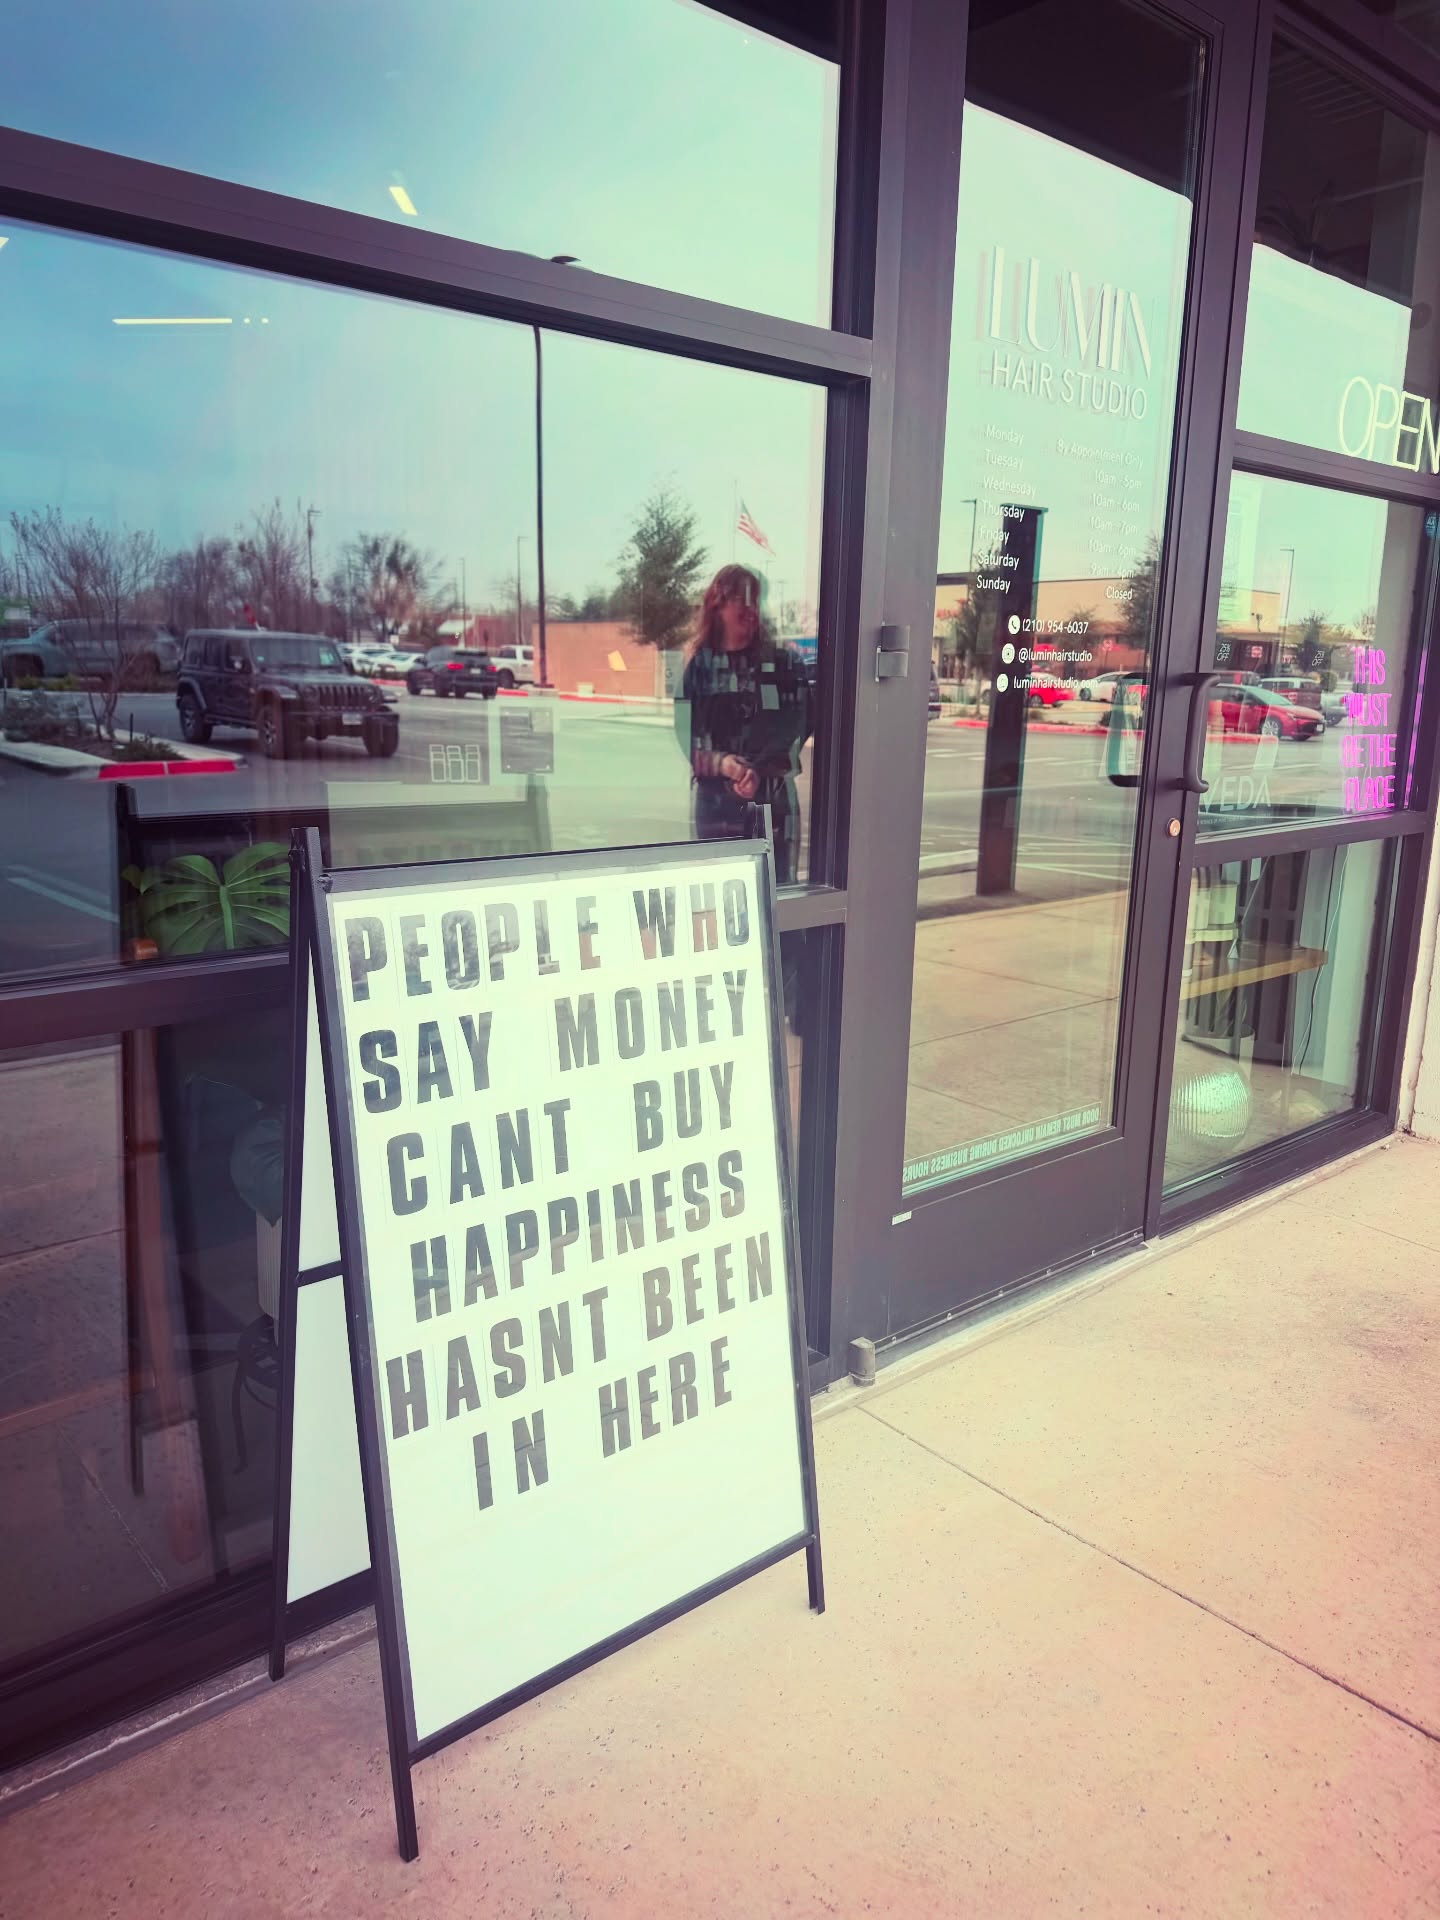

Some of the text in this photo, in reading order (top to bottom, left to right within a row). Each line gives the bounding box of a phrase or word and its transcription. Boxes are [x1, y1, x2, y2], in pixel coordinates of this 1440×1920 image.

[989, 245, 1152, 379] LUMIN
[991, 349, 1148, 421] HAIR STUDIO
[986, 423, 1024, 447] Monday
[1338, 375, 1440, 475] OPEN
[985, 448, 1024, 473] Tuesday
[1071, 441, 1123, 466] Appointment
[1125, 452, 1144, 471] Only
[983, 475, 1037, 499] Wednesday
[981, 500, 1025, 522] Thursday
[980, 526, 1010, 546] Friday
[977, 551, 1020, 571] Saturday
[976, 574, 1011, 594] Sunday
[1106, 586, 1133, 601] Closed
[1022, 618, 1089, 634] (210) 954-6037
[1018, 647, 1092, 664] @luminhairstudio
[1216, 652, 1229, 661] OFF
[1351, 645, 1386, 686] THIS
[1013, 676, 1099, 689] luminhairstudio.com
[1363, 733, 1398, 768] THE
[1345, 775, 1396, 812] PLACE
[344, 879, 750, 1002] PEOPLE WHO
[359, 969, 748, 1114] SAY MONEY
[386, 1061, 734, 1216] CANT BUY
[410, 1149, 745, 1323] HAPPINESS
[386, 1231, 773, 1440] HASNT BEEN
[472, 1336, 732, 1511] IN HERE
